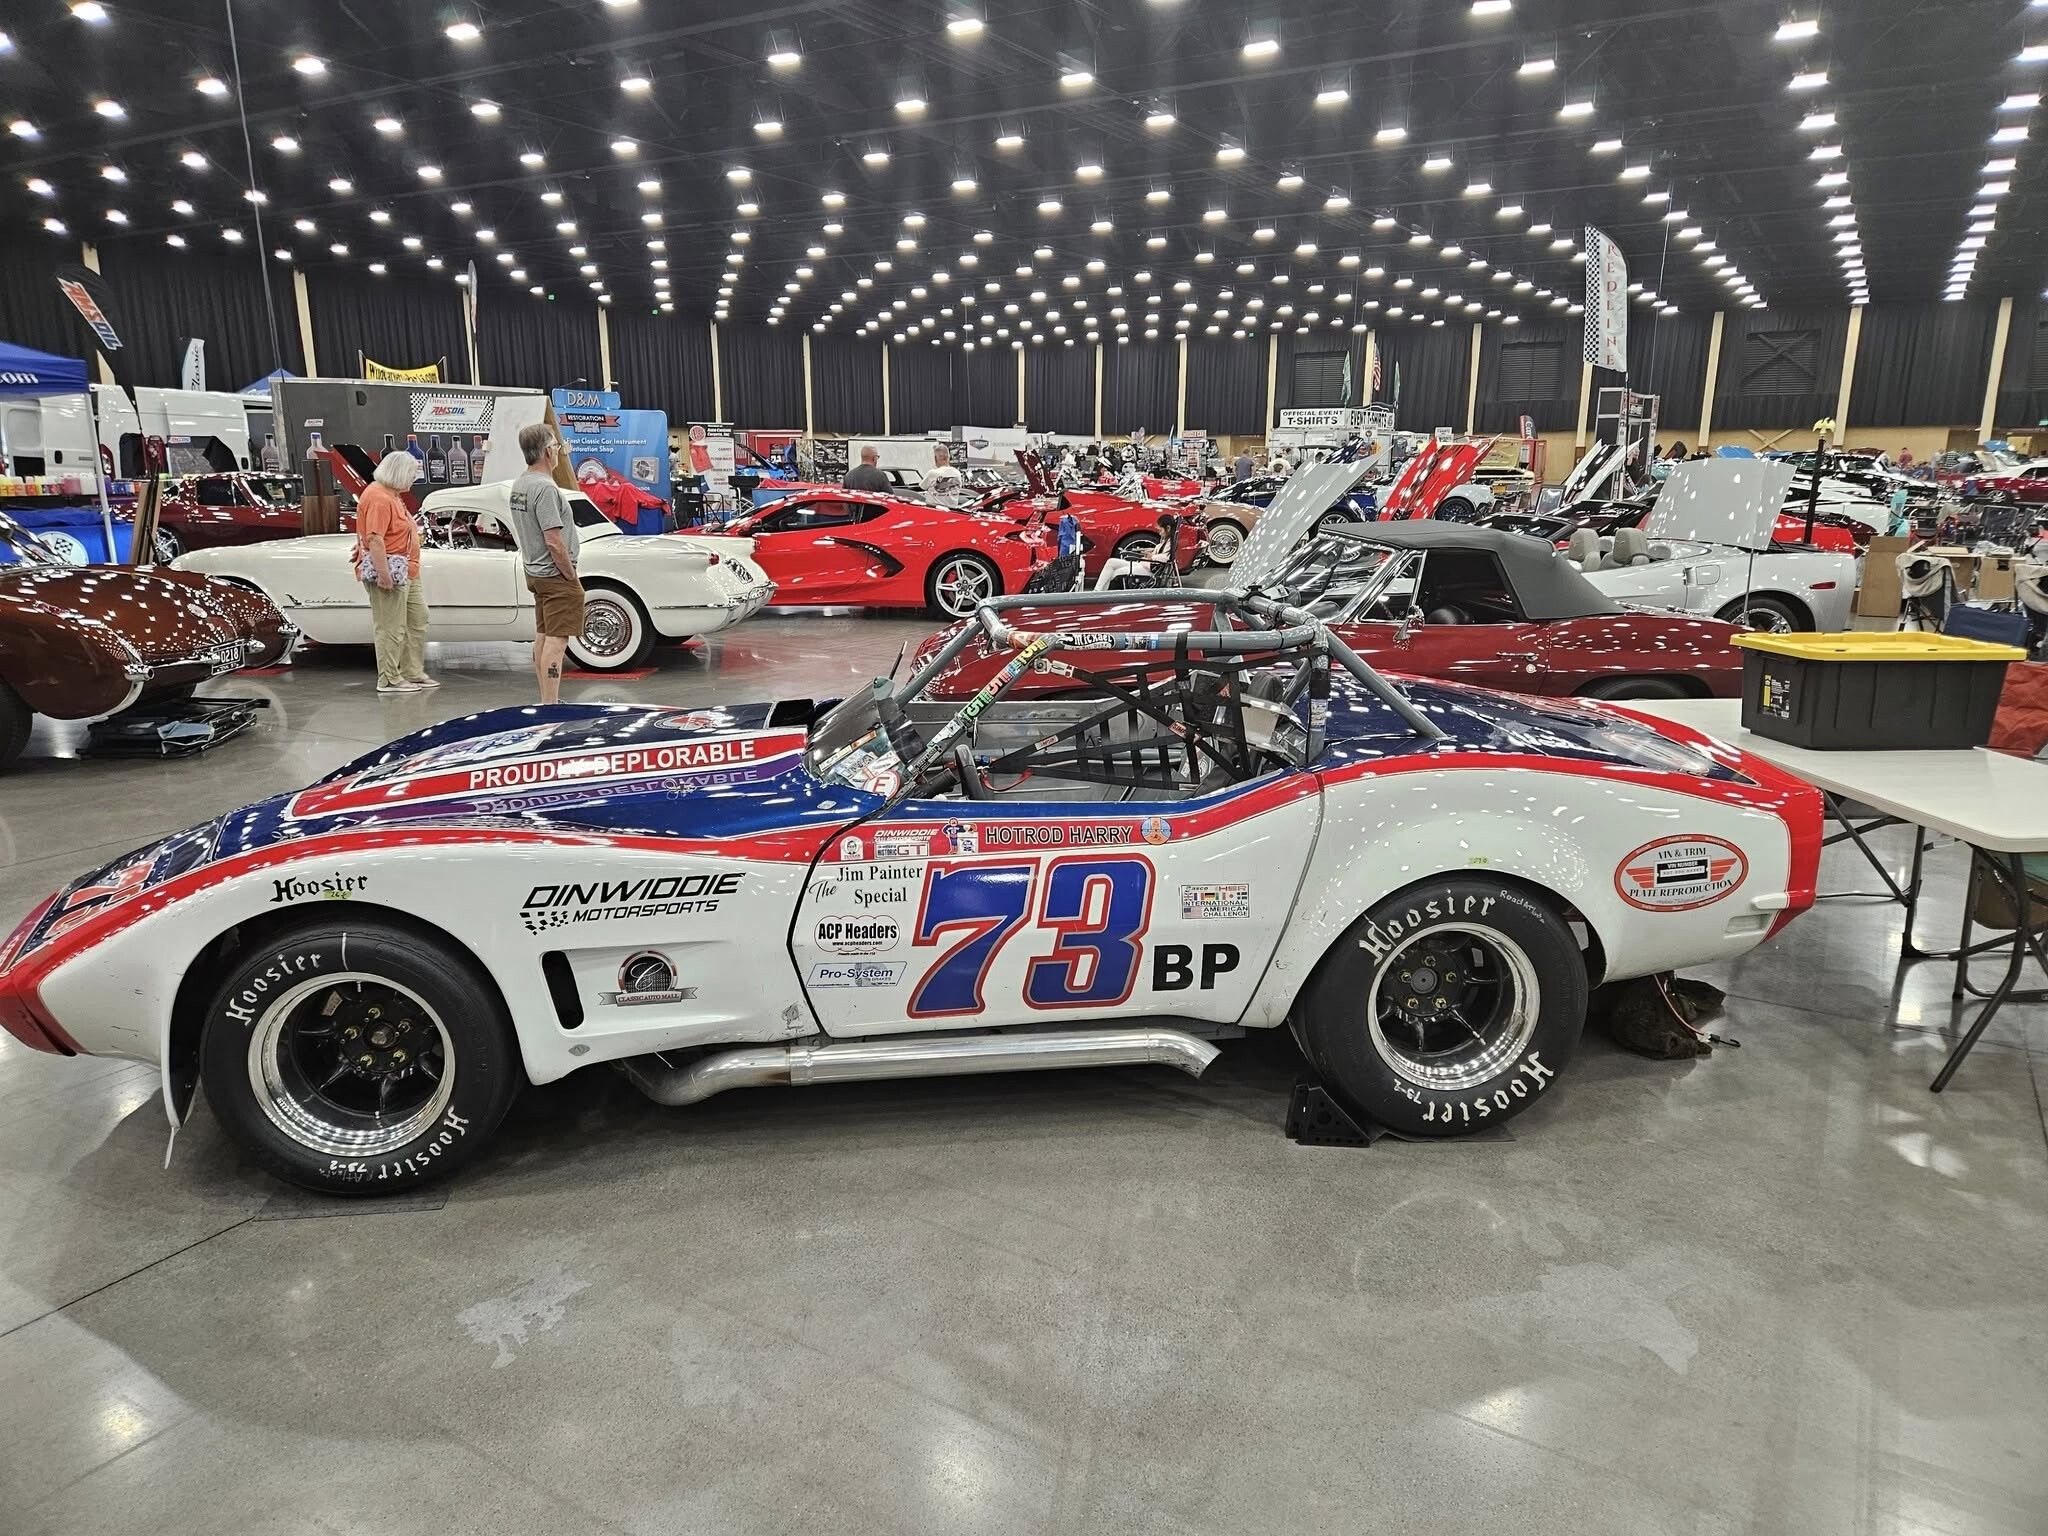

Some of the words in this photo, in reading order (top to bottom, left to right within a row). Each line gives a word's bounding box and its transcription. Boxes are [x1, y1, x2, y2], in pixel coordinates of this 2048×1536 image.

[0, 371, 39, 384] om
[567, 391, 601, 407] D&M
[431, 406, 465, 416] AMSOIL
[1287, 416, 1338, 426] T-SHIRTS
[581, 437, 600, 445] Classic
[599, 446, 615, 454] Shop
[220, 647, 239, 664] 0218
[593, 741, 756, 777] DEPLORABLE
[873, 828, 940, 837] DINWIDDIE
[985, 826, 1065, 846] HOTROD
[1069, 825, 1134, 844] HARRY
[1658, 850, 1673, 860] VIN
[1674, 849, 1683, 858] &
[1683, 847, 1707, 857] TRIM
[836, 866, 864, 882] Jim
[869, 864, 924, 881] Painter
[269, 871, 369, 903] Hoosier
[521, 872, 747, 909] DINWIDDIE
[808, 880, 837, 904] The
[1629, 888, 1659, 898] PLATE
[1659, 878, 1733, 898] REPRODUCTION
[854, 887, 908, 909] Special
[572, 899, 720, 923] MOTORSPORTS
[818, 923, 842, 940] ACP
[845, 922, 898, 939] Headers
[906, 852, 1156, 1020] 73
[1358, 888, 1498, 967] Hoosier
[819, 968, 893, 980] Pro-System
[1151, 942, 1241, 992] BP
[226, 952, 322, 1026] Hoosier
[1422, 1050, 1555, 1128] Hoosier
[377, 1104, 470, 1181] Hoosier
